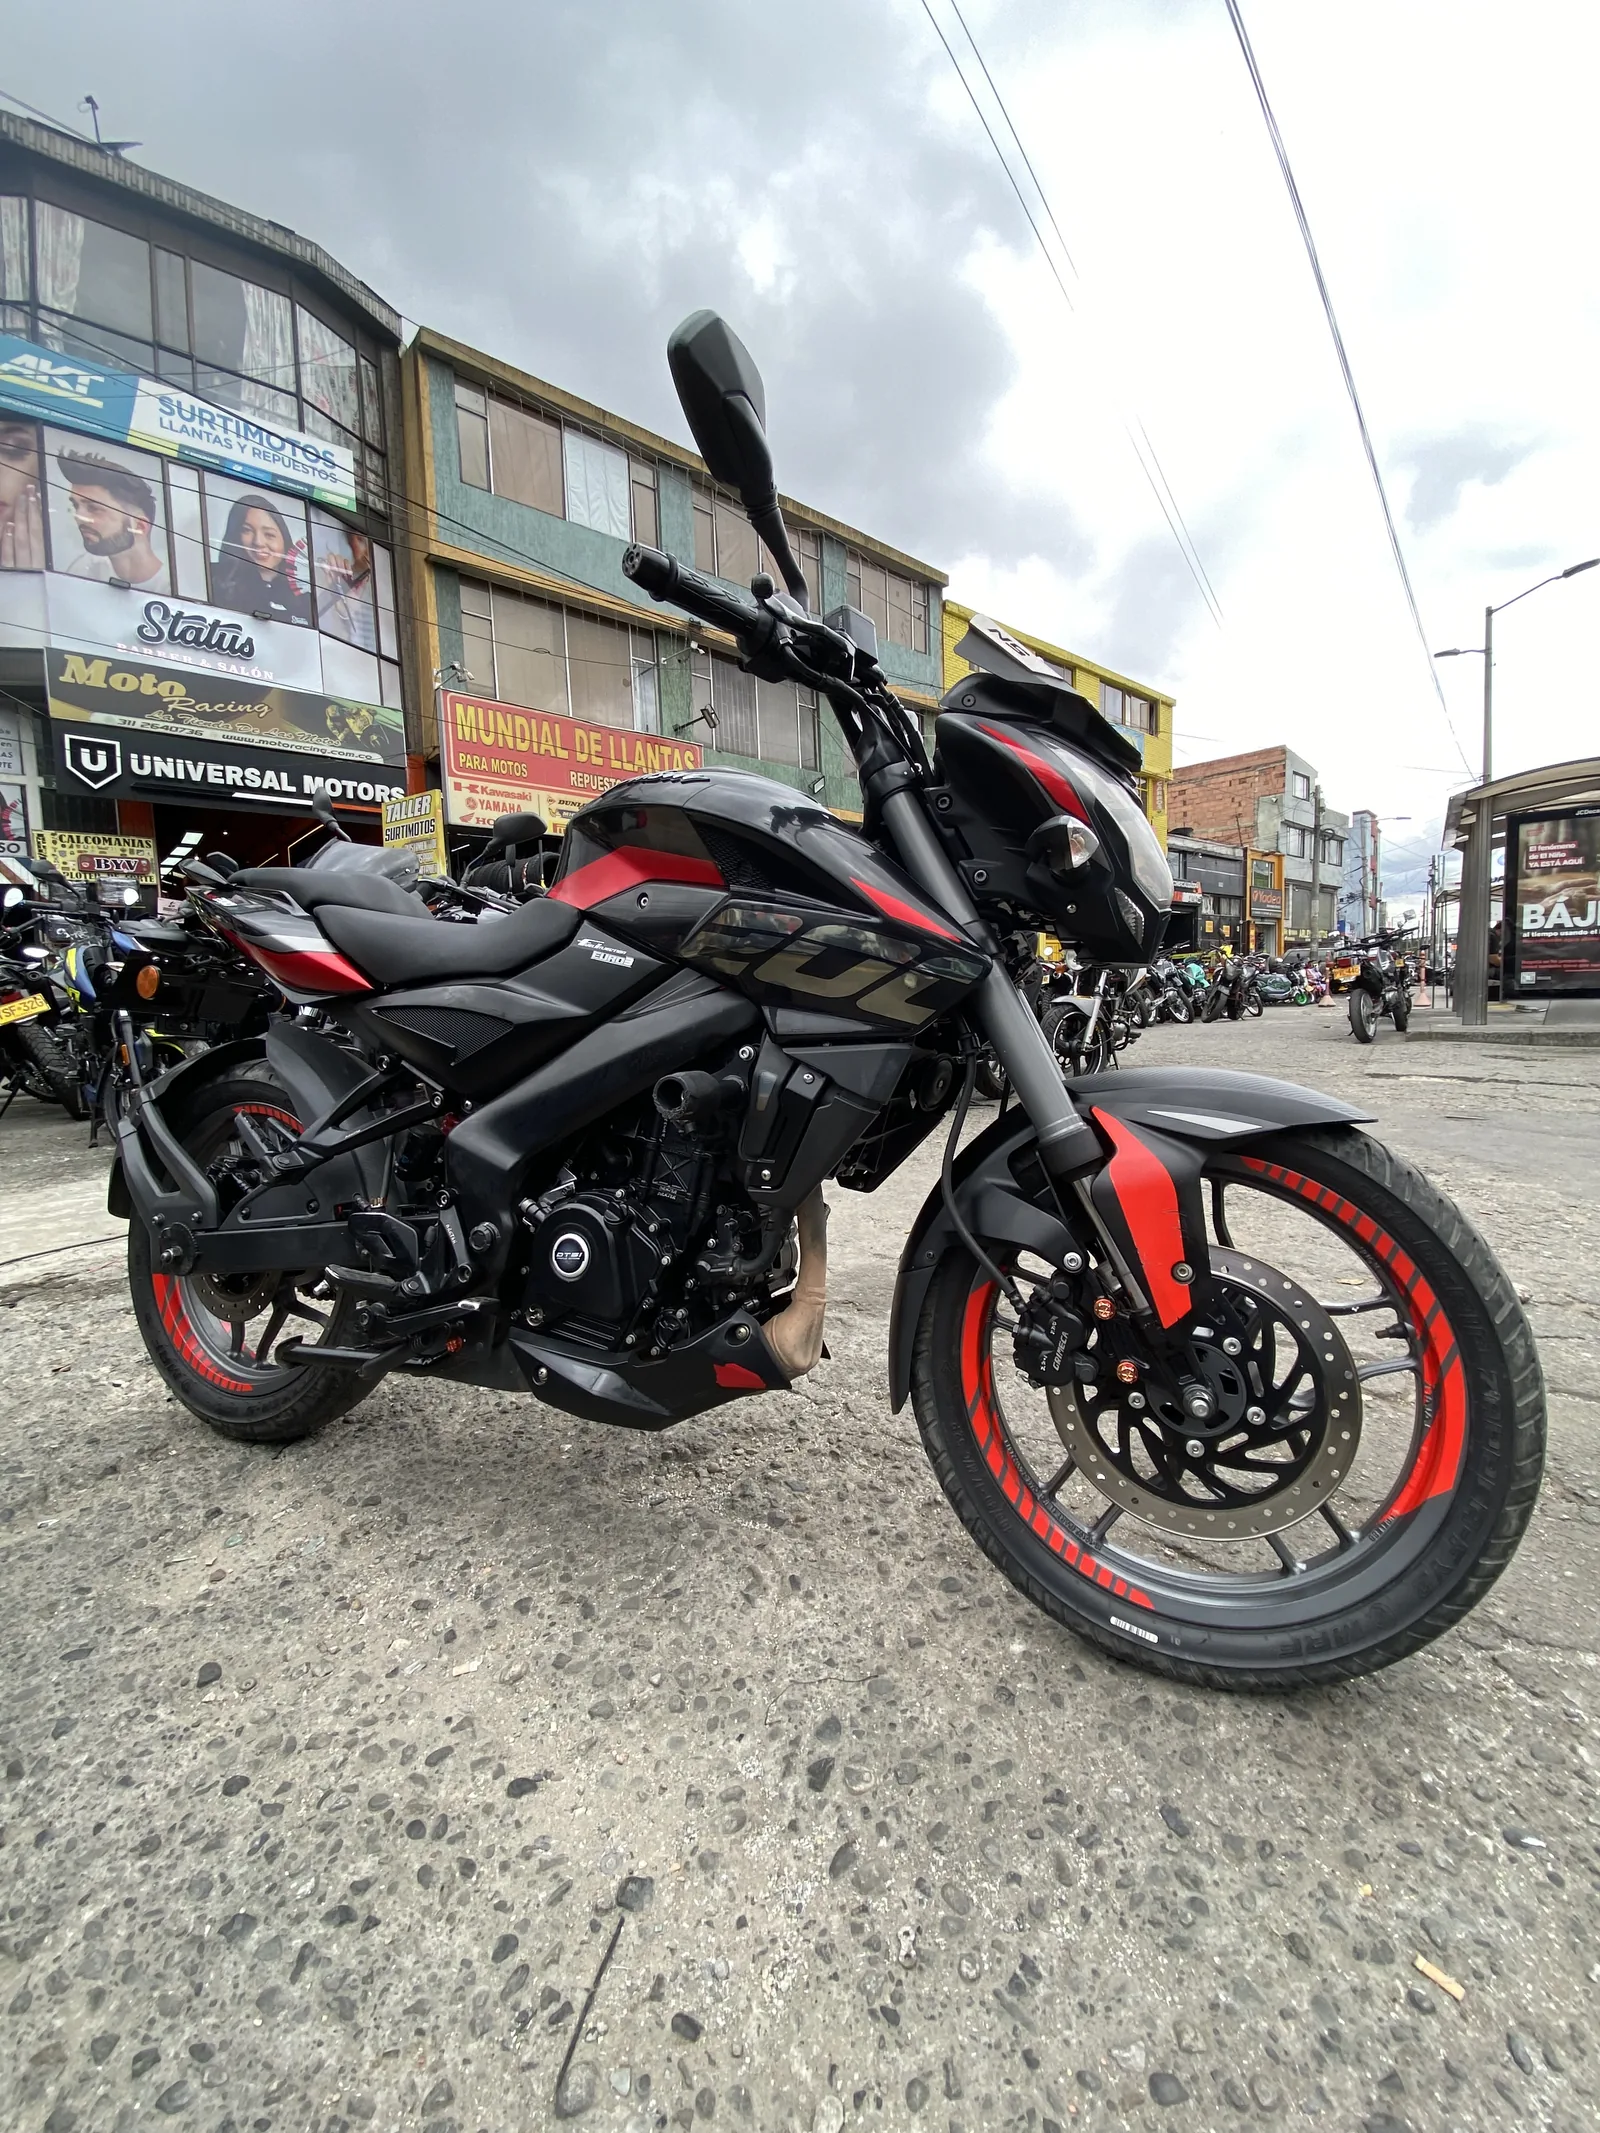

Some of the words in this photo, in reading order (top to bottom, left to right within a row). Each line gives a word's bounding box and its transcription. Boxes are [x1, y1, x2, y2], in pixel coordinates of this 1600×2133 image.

[0, 354, 104, 395] AKT
[159, 395, 336, 469] SURTIMOTOS
[160, 417, 233, 449] LLANTAS
[238, 441, 248, 453] Y
[252, 447, 338, 483] REPUESTOS
[137, 601, 255, 659] Status
[59, 654, 187, 697] Moto
[218, 660, 274, 680] SALÓN
[163, 696, 272, 718] Racing
[140, 722, 203, 737] 2640736
[145, 710, 174, 722] La
[178, 714, 233, 731] Tienda
[235, 723, 260, 734] De
[264, 728, 295, 739] Las
[297, 732, 341, 747] Motos
[456, 703, 569, 760] MUNDIAL
[574, 727, 604, 767] DE
[609, 735, 694, 775] LLANTAS
[222, 733, 372, 760] www.motoracing.com.co
[130, 753, 297, 793] UNIVERSAL
[303, 774, 405, 803] MOTORS
[459, 753, 488, 771] PARA
[491, 760, 528, 778] MOTOS
[481, 785, 532, 802] Kawasaki
[386, 795, 431, 823] TALLER
[479, 800, 522, 813] YAMAHA
[59, 834, 152, 848] CALCOMANIAS
[385, 819, 435, 841] SURTIMOTOS
[1538, 843, 1576, 851] fenómeno
[94, 858, 139, 872] BYV
[1541, 859, 1561, 867] ESTÁ
[1563, 857, 1583, 866] AQUÍ
[1258, 890, 1282, 904] Yadea
[1052, 1331, 1069, 1372] GRIMECA
